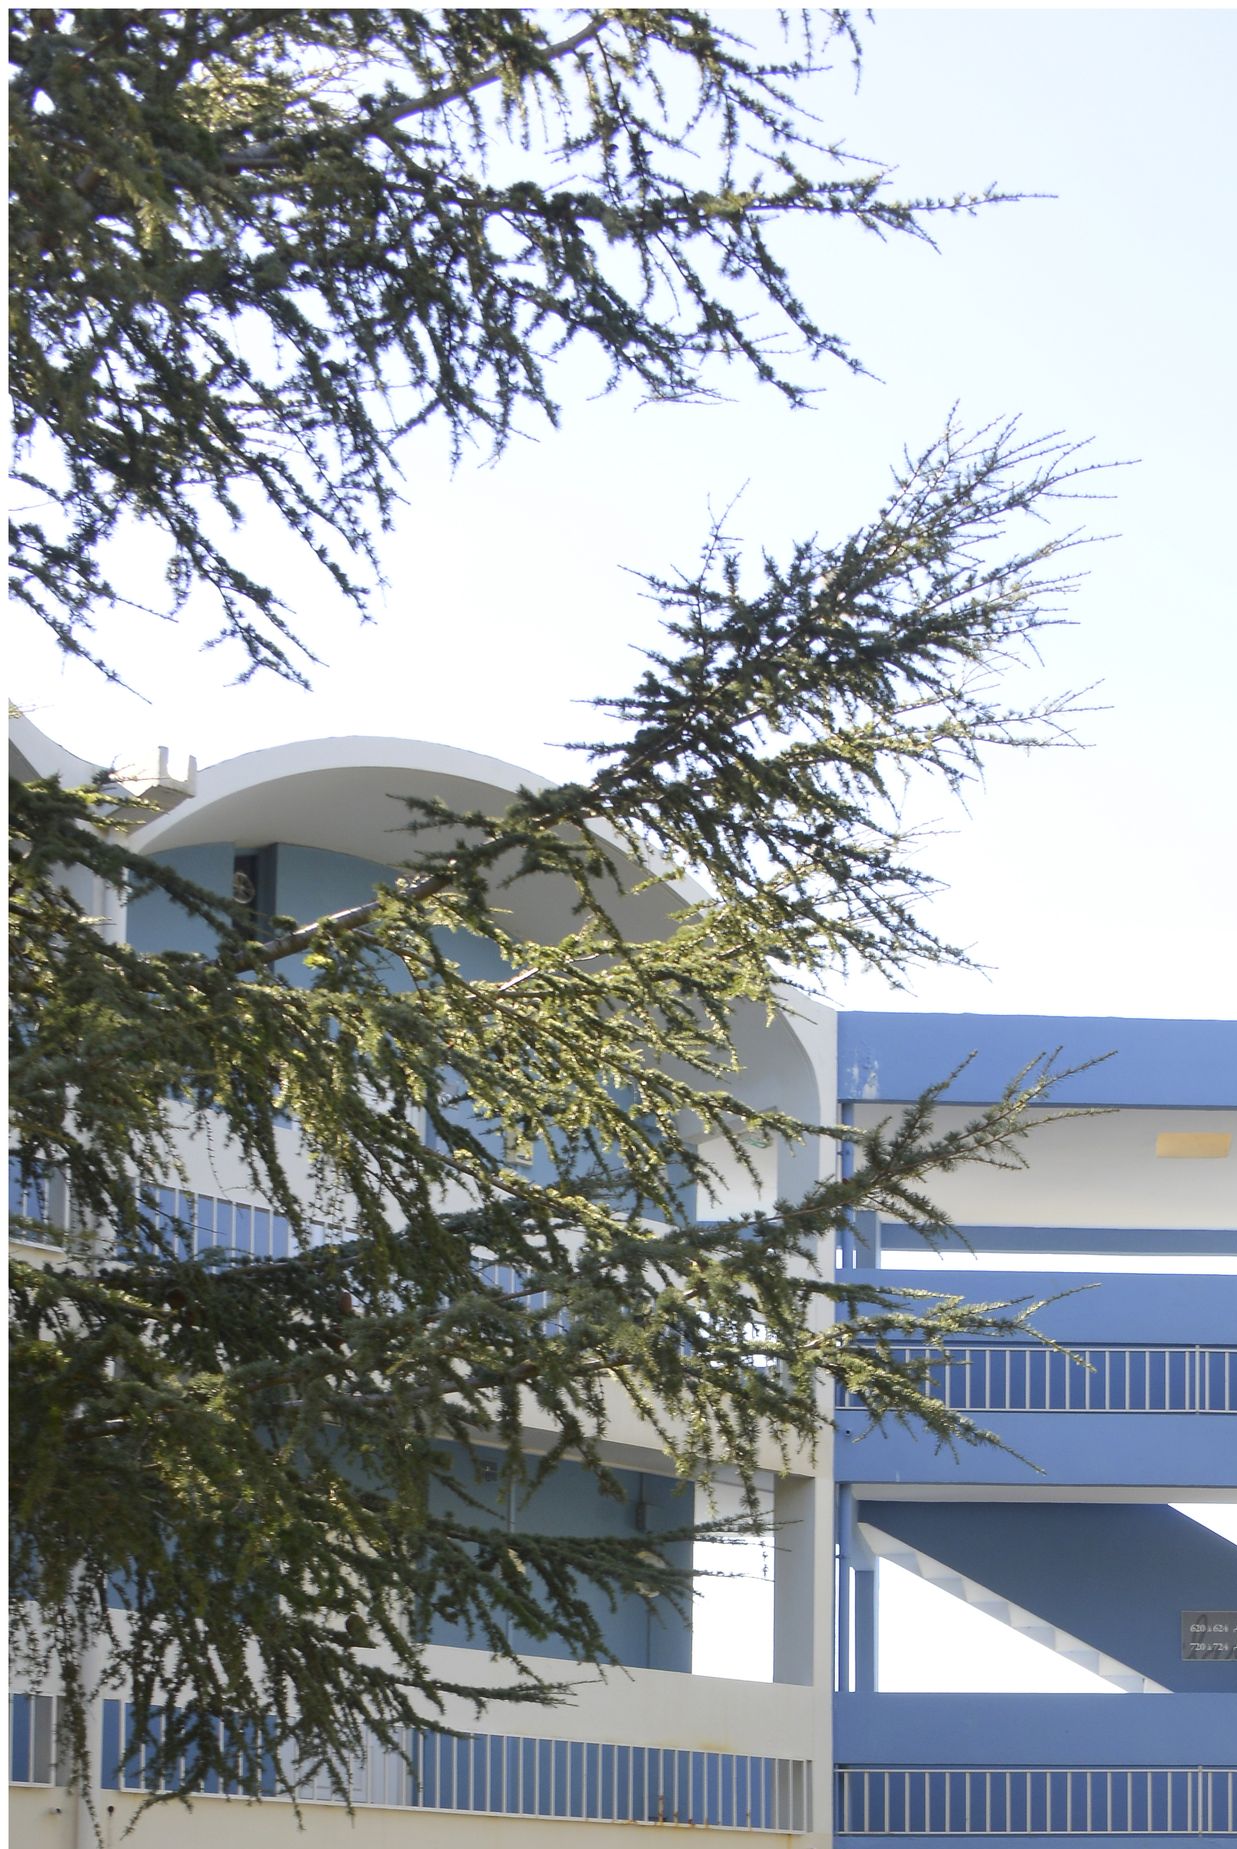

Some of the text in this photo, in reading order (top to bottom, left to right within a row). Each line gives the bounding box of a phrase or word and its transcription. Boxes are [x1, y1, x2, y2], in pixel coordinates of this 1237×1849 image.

[1190, 1624, 1206, 1633] 620
[1213, 1624, 1229, 1633] 624
[1190, 1642, 1206, 1651] 720
[1213, 1642, 1229, 1651] 724
